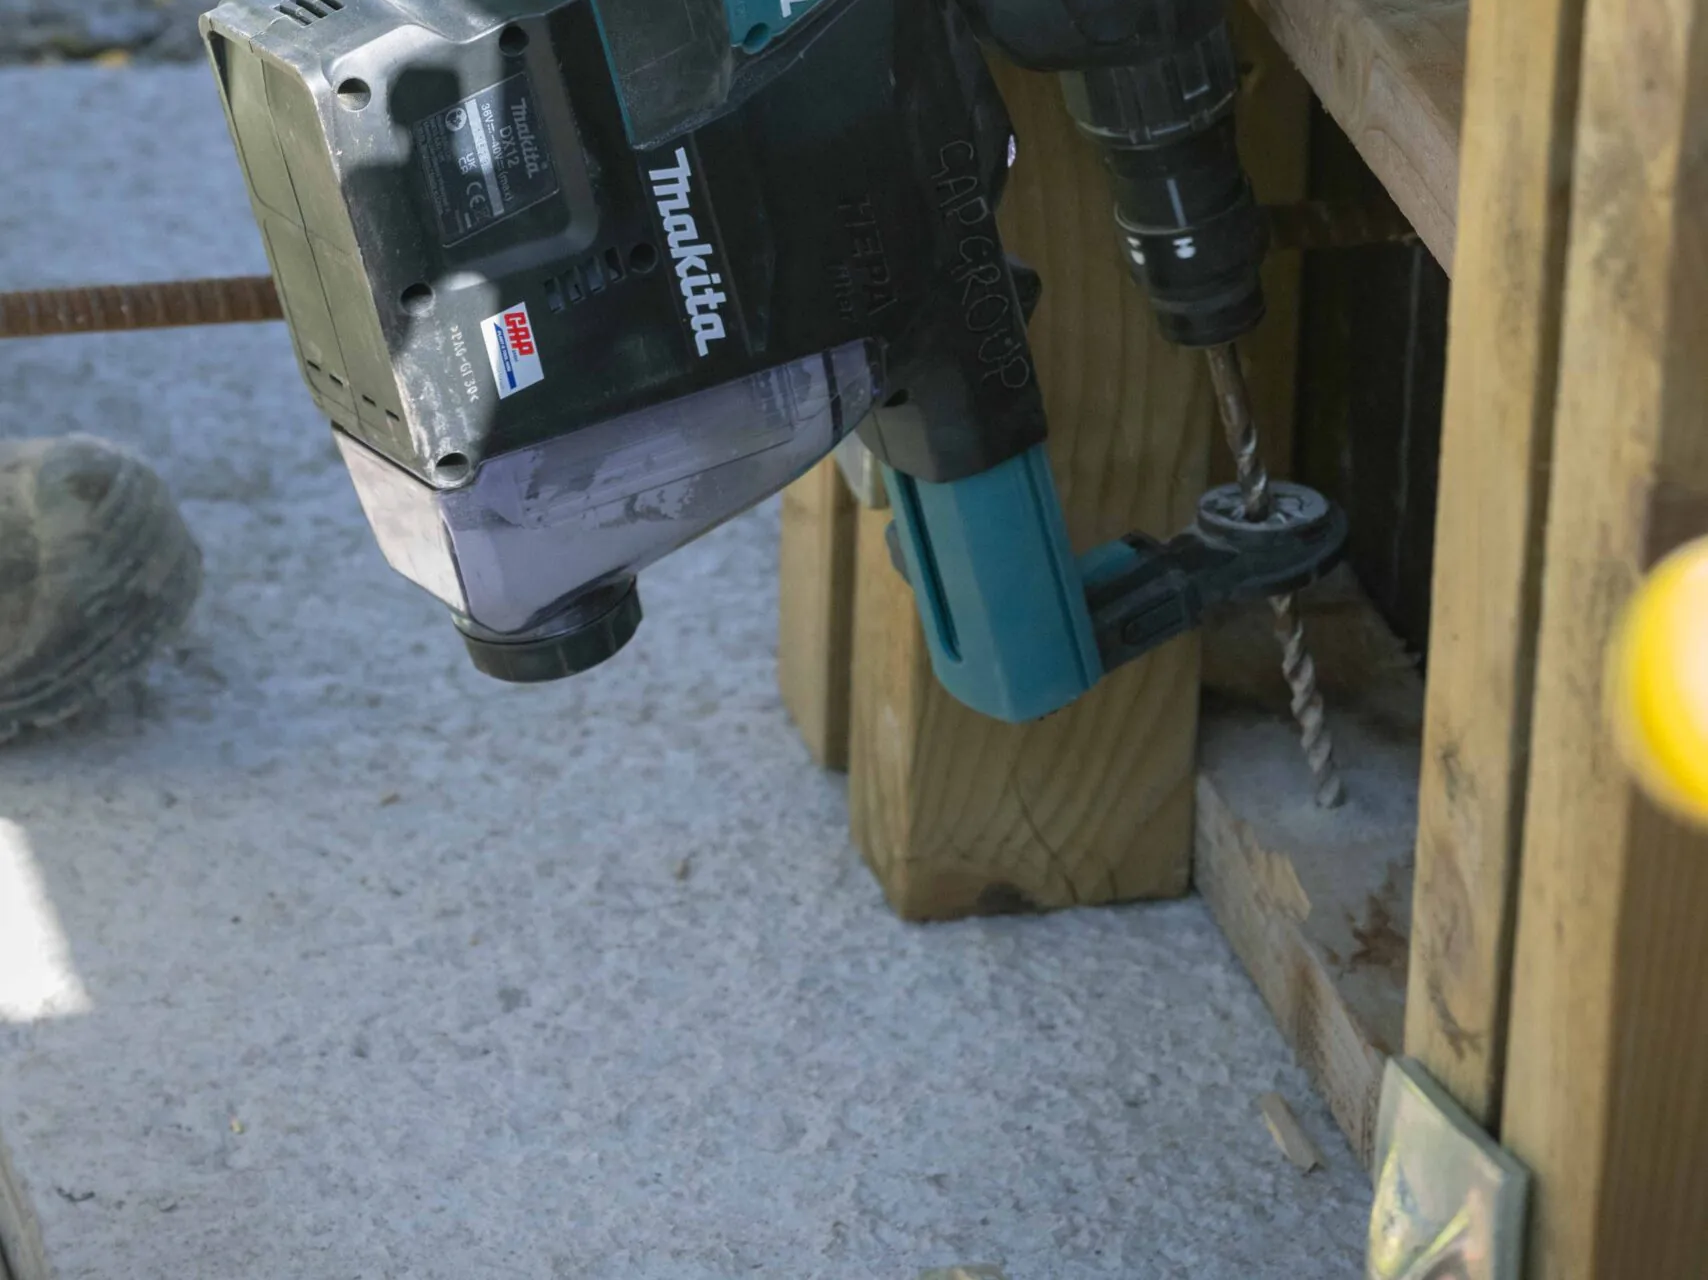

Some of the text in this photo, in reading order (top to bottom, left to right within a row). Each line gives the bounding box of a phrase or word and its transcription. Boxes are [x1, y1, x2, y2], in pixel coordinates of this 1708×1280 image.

[499, 125, 519, 168] DX12
[930, 139, 1030, 387] GAP GROUP
[503, 311, 534, 355] GAP
